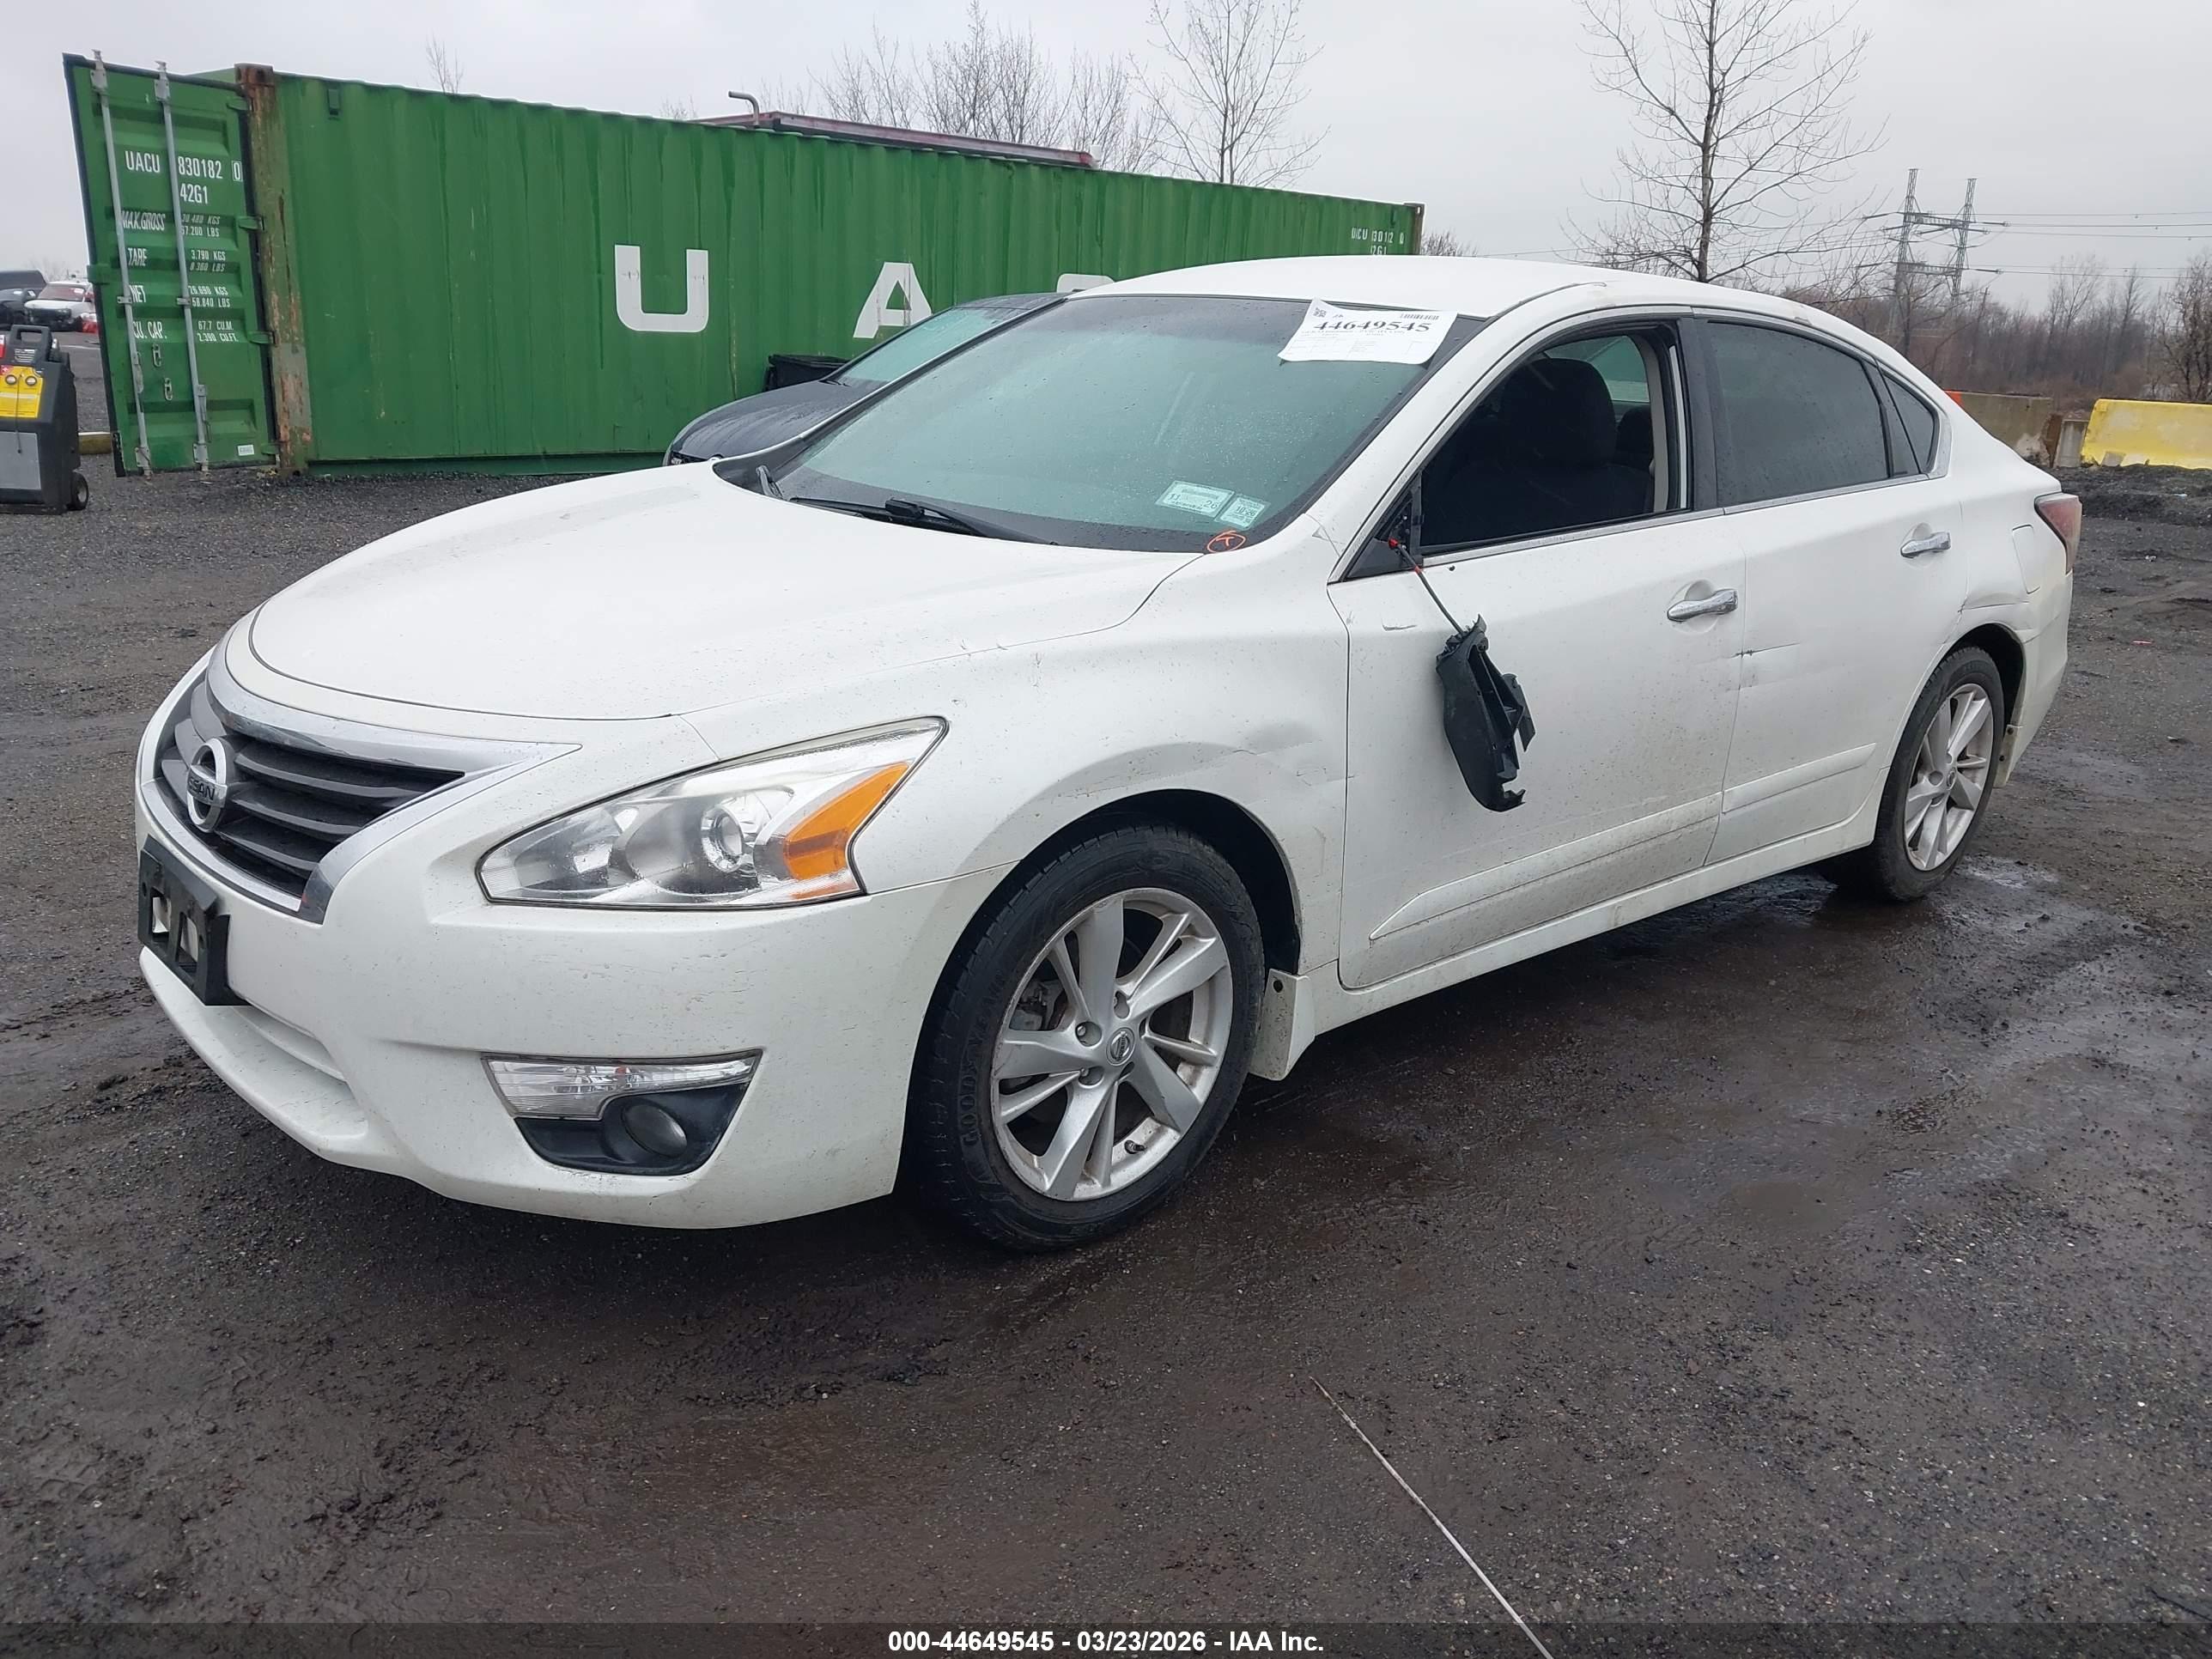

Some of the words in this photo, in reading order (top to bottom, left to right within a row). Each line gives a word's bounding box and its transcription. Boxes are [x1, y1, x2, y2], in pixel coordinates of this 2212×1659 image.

[125, 150, 161, 173] UACU
[177, 155, 223, 179] 830182
[233, 161, 241, 180] 0
[180, 183, 208, 204] 42G1
[207, 215, 220, 225] KGS
[207, 227, 220, 238] LBS
[128, 247, 148, 267] TARE
[213, 250, 226, 261] KGS
[212, 263, 226, 272] LBS
[129, 284, 147, 303] NET
[214, 286, 228, 295] KGS
[217, 297, 230, 307] LBS
[1313, 320, 1432, 332] 44649545
